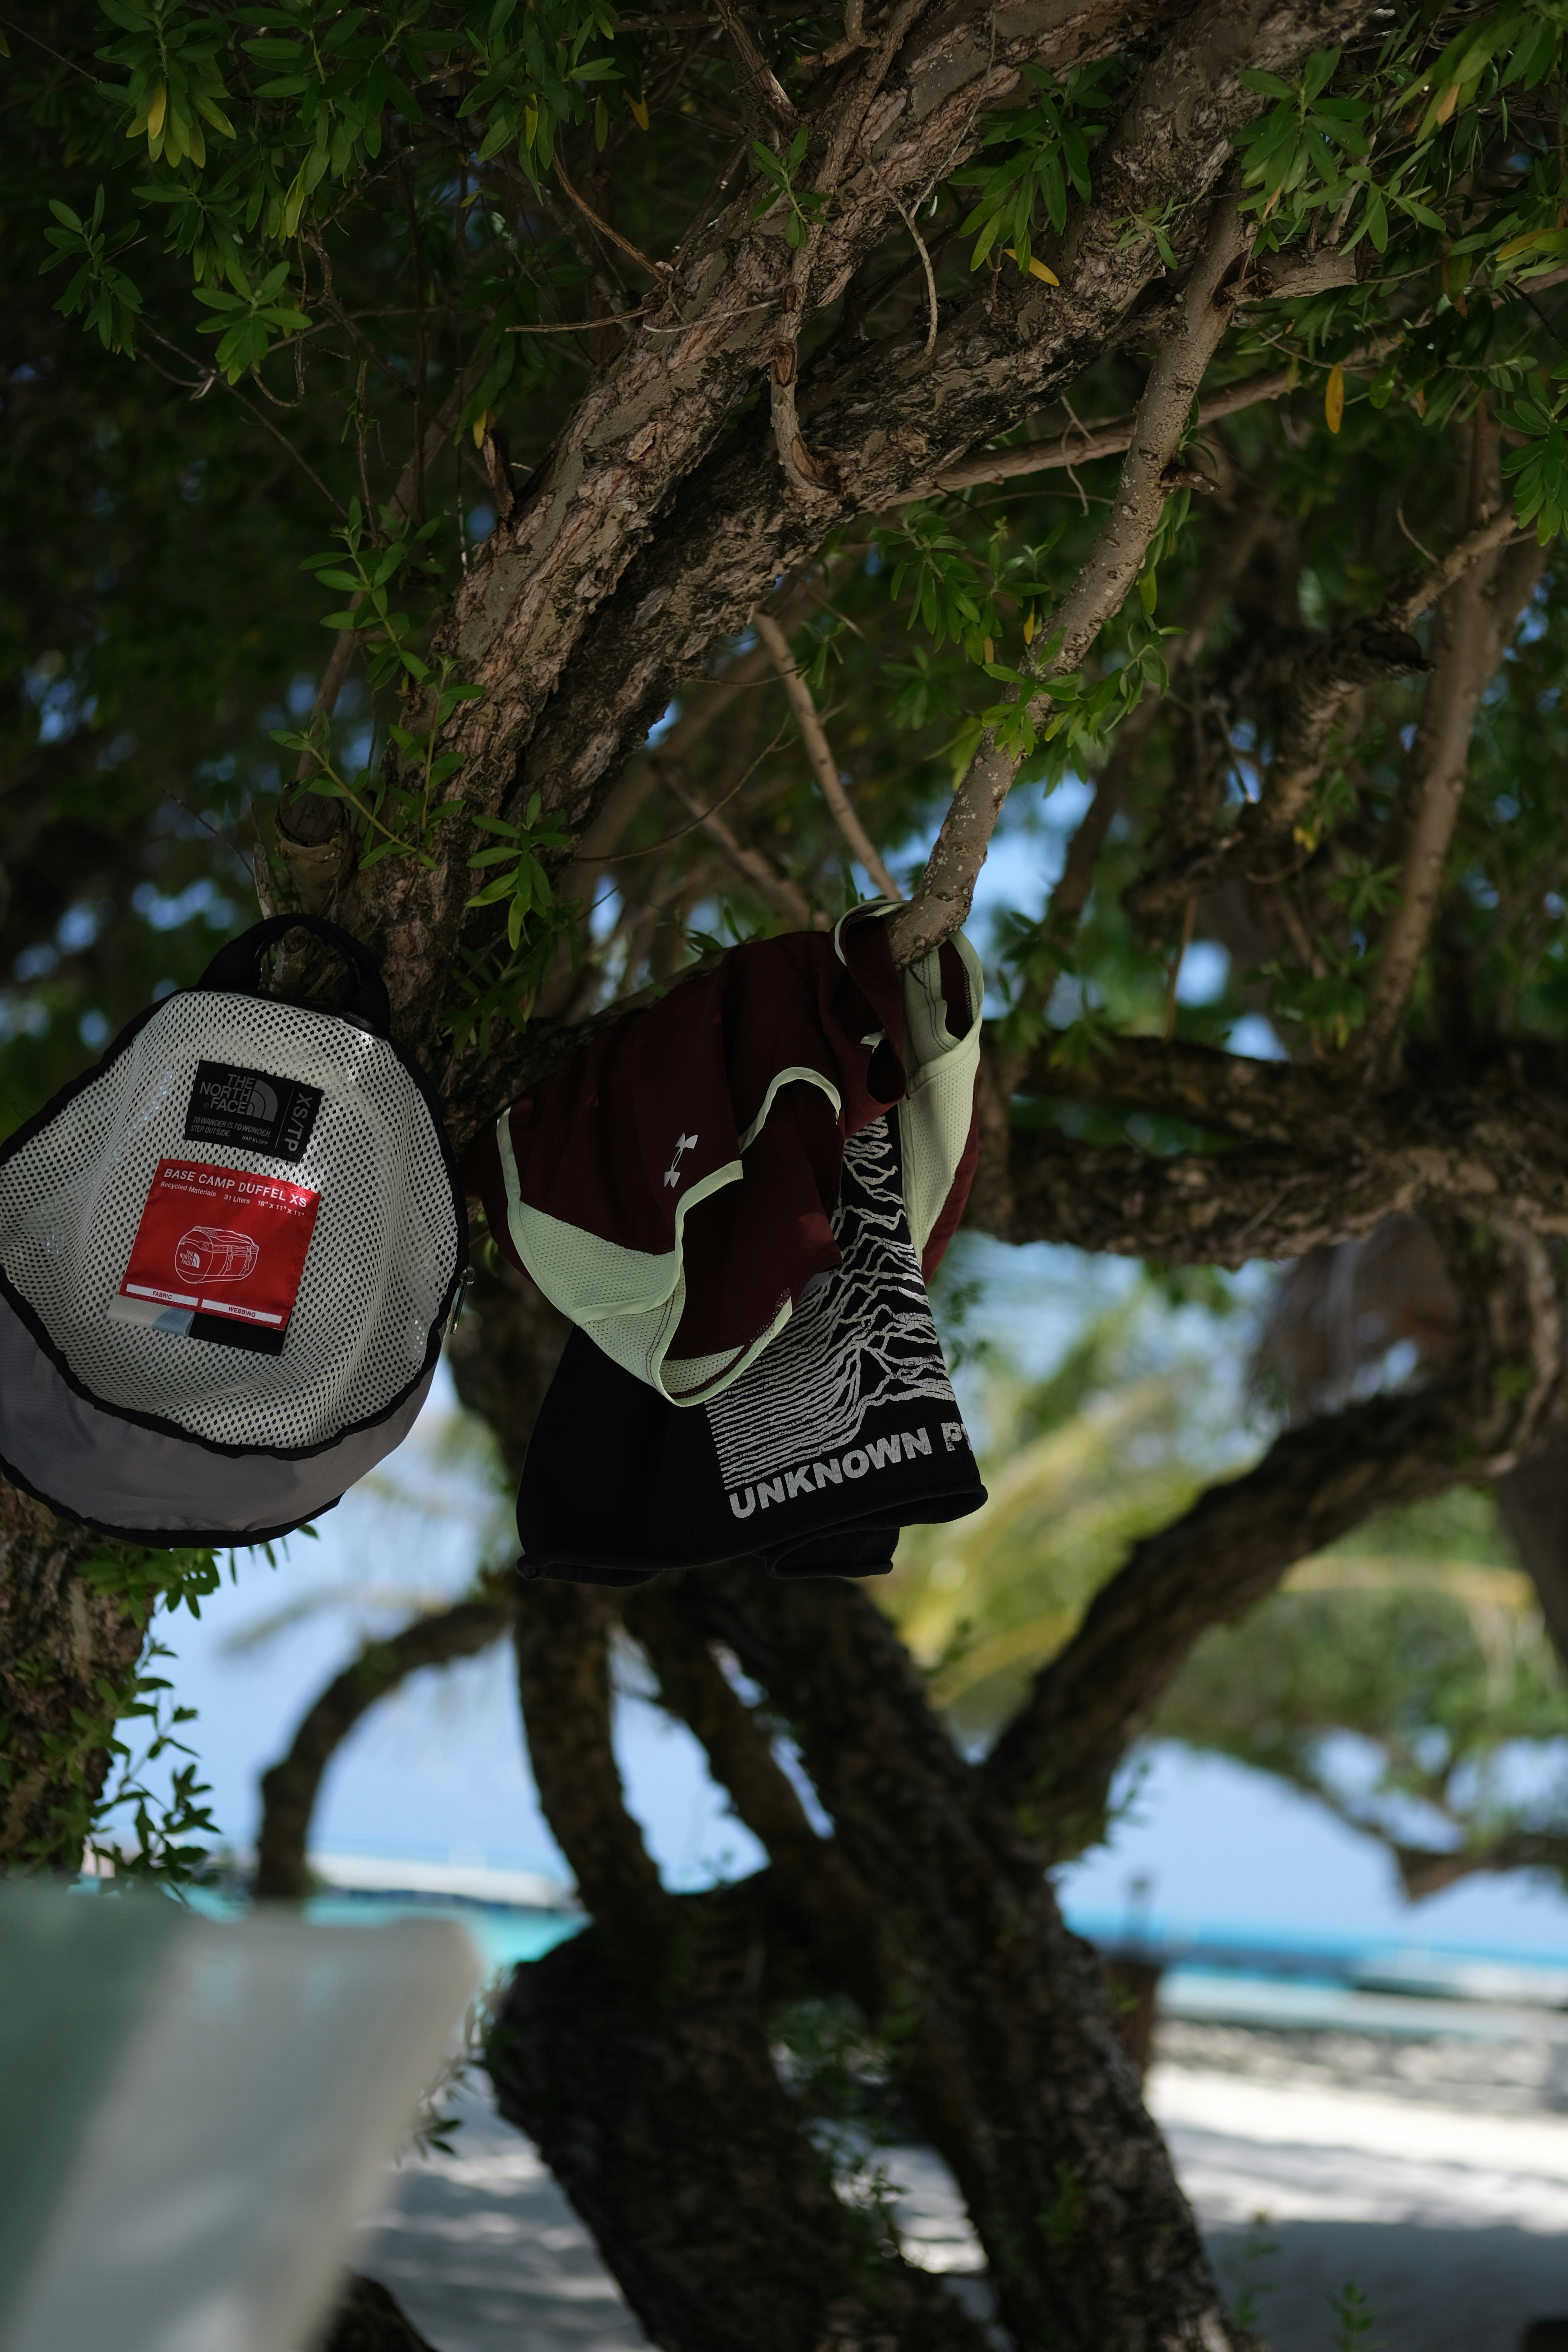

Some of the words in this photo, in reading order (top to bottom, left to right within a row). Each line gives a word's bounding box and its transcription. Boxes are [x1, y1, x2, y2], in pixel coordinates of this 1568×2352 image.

[228, 1073, 256, 1089] THE
[199, 1081, 252, 1102] NORTH
[210, 1096, 248, 1115] FACE
[201, 1118, 227, 1128] WANDER
[285, 1092, 313, 1152] XS/TP
[160, 1181, 188, 1191] Recycled
[188, 1186, 217, 1197] Materials
[164, 1168, 196, 1181] BASE
[199, 1174, 235, 1189] CAMP
[238, 1182, 286, 1201] DUFFEL
[289, 1194, 307, 1208] XS
[180, 1253, 193, 1261] NORTH
[152, 1291, 172, 1300] FABRIC
[228, 1306, 256, 1318] WEBBING
[729, 1427, 933, 1518] UNKNOWN
